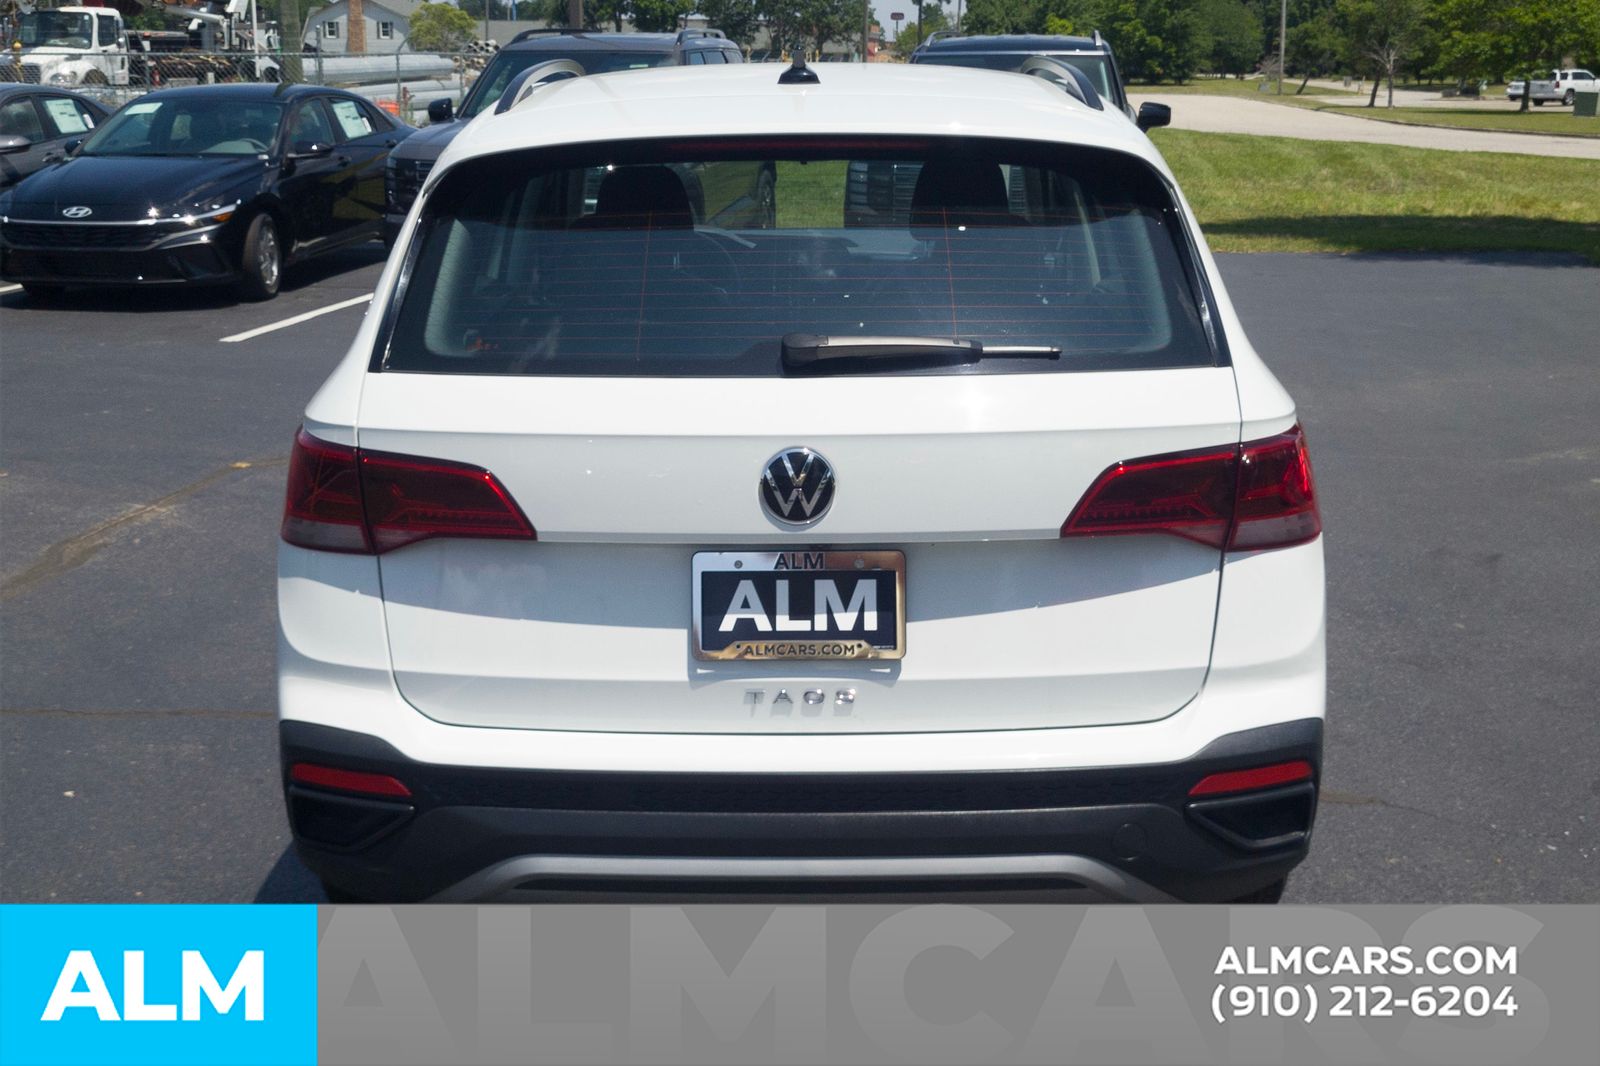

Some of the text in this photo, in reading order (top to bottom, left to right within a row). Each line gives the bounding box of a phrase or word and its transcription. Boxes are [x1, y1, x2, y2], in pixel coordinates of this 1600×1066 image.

[773, 552, 824, 570] ALM
[718, 579, 878, 632] ALM
[744, 643, 855, 656] ALMCARS.COM
[745, 688, 856, 704] TAOS
